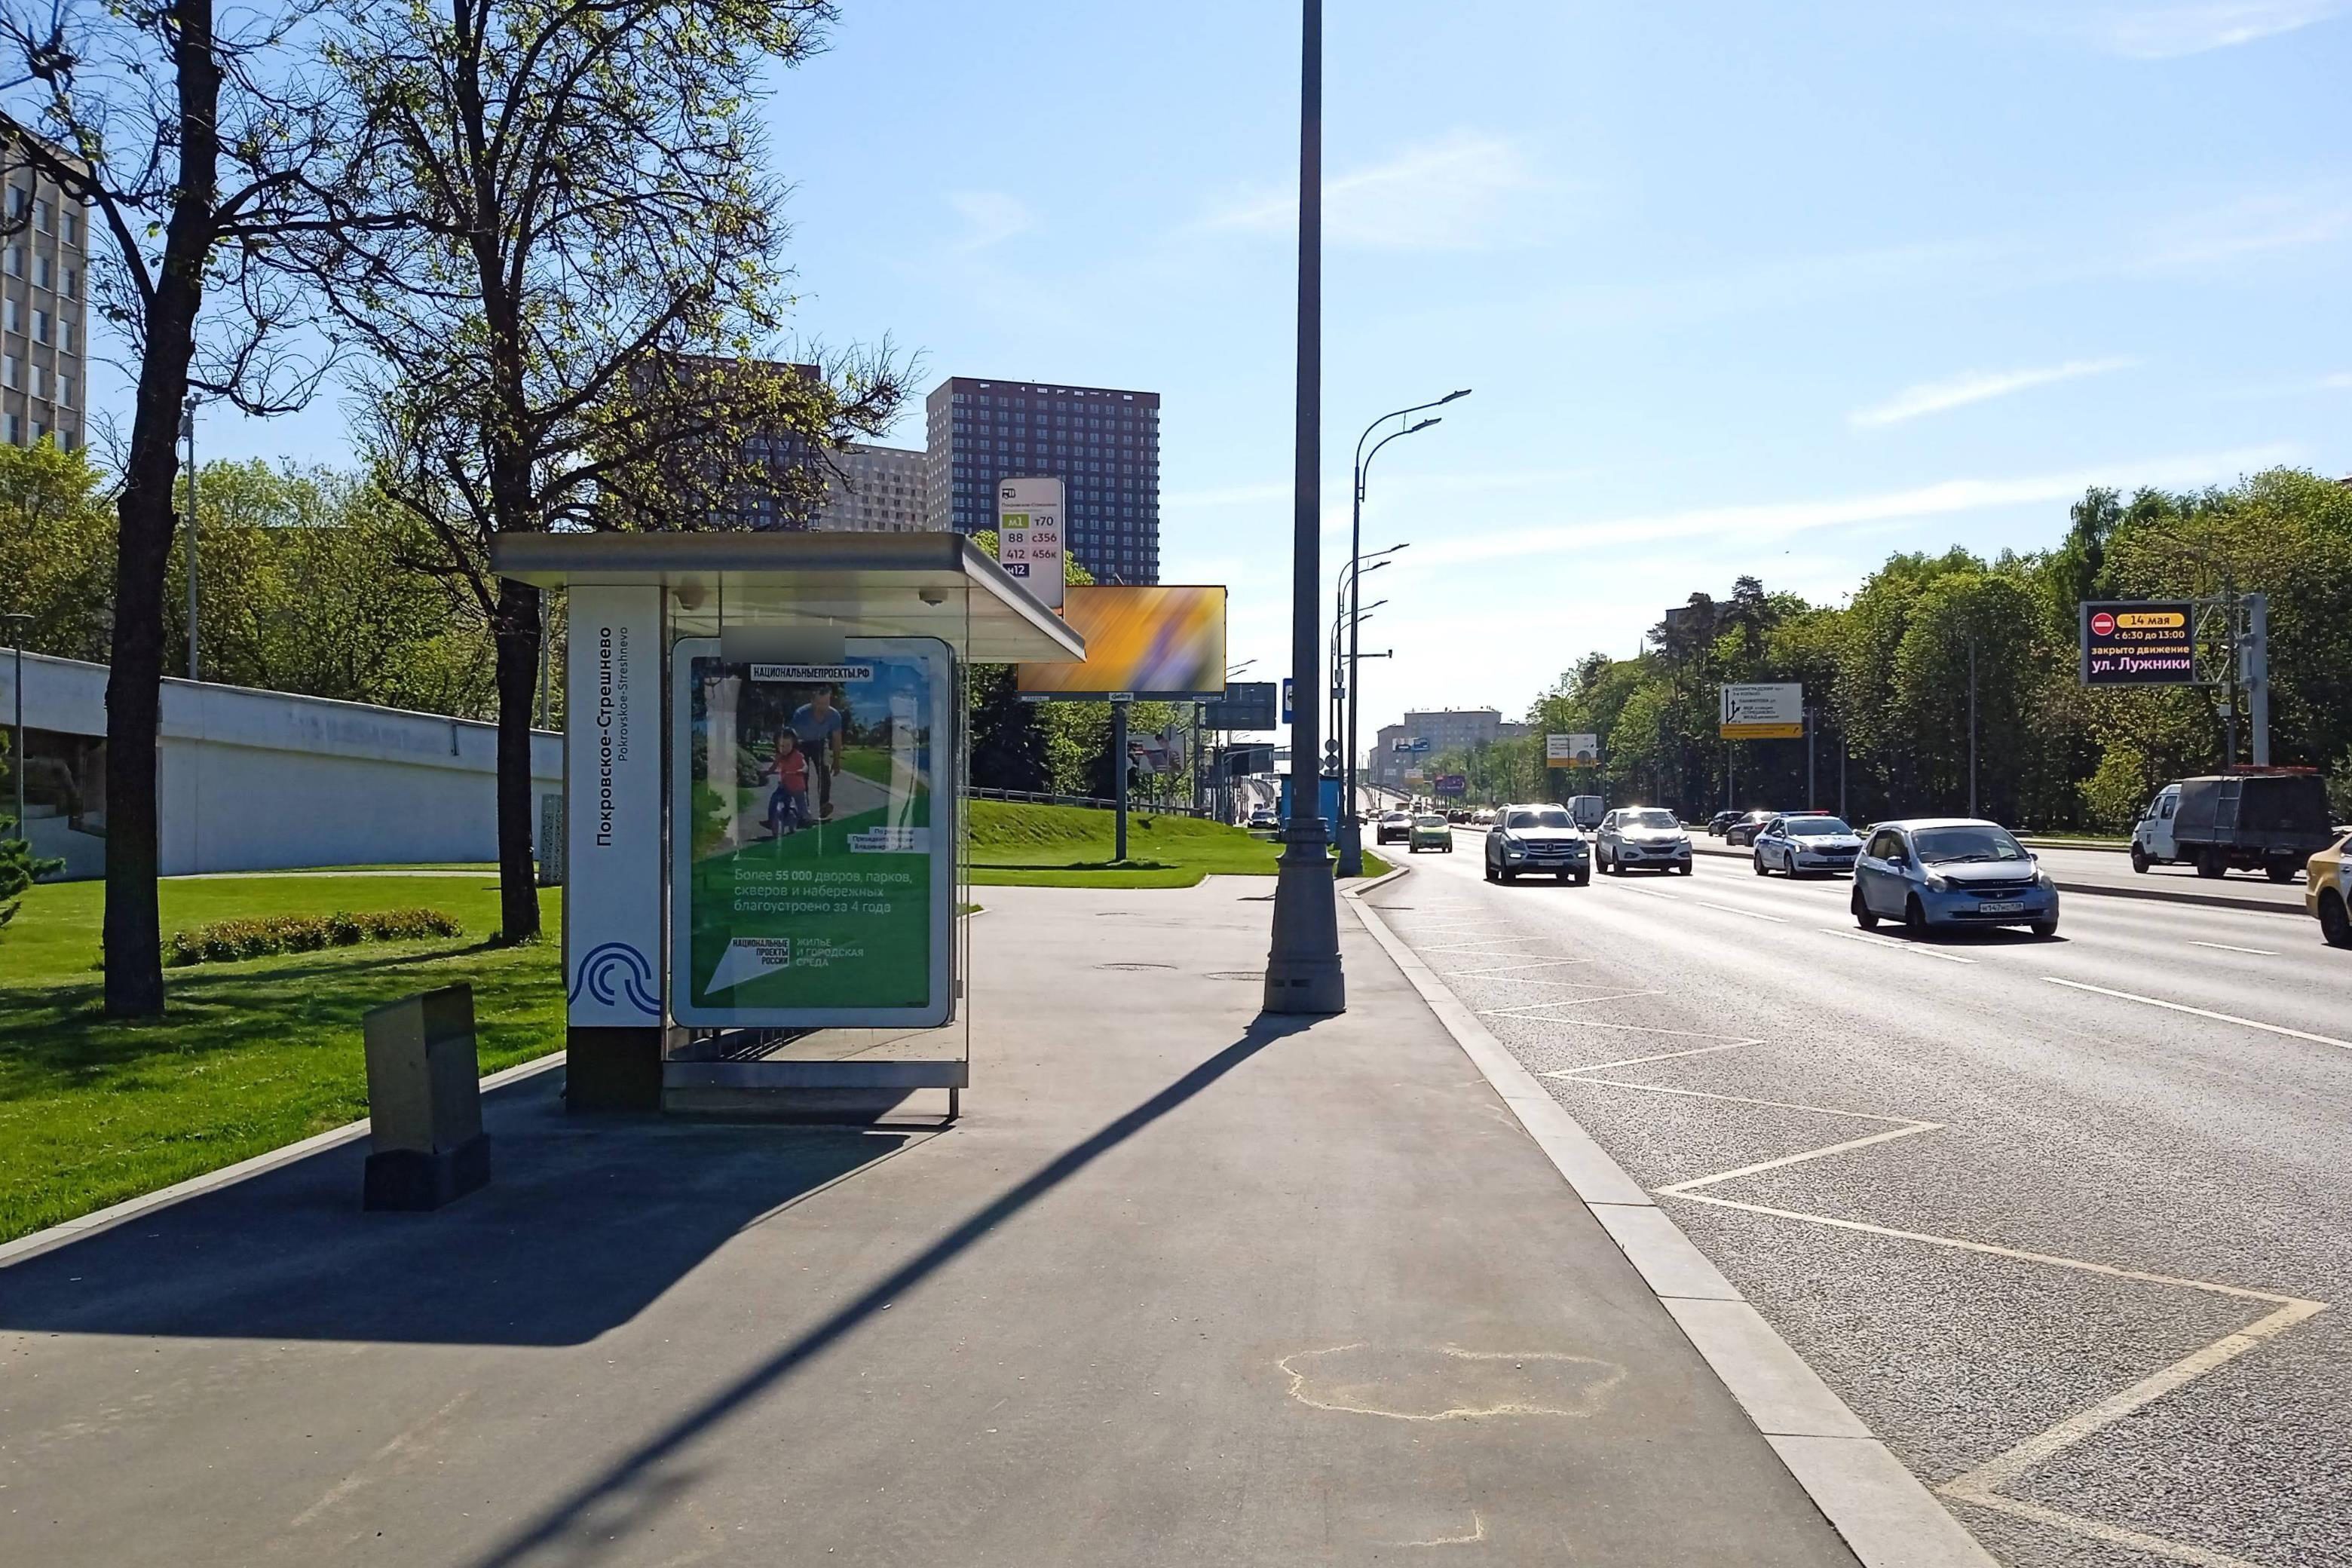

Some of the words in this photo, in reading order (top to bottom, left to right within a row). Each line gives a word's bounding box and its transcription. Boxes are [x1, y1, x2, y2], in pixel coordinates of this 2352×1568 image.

[1008, 517, 1024, 526] м1
[1034, 516, 1054, 526] т70
[1009, 533, 1024, 543] 88
[1032, 533, 1057, 543] с356
[1007, 550, 1025, 559] 412
[1032, 550, 1057, 559] 456к
[2130, 615, 2144, 625] 14
[2148, 617, 2170, 626] мая
[2122, 631, 2143, 639] 6:30
[2145, 632, 2157, 641] до
[2158, 630, 2185, 639] 13:00
[2091, 647, 2135, 656] закрыто
[2136, 645, 2190, 656] движение
[2091, 660, 2115, 674] ул.
[2118, 657, 2191, 673] Лужники
[754, 666, 870, 679] НАЦИОНАЛЬНЫЕПРОЕКТЫ.РФ
[618, 626, 629, 761] Pokrovskoe-Streshnevo
[596, 626, 615, 847] Покровское-Стрешнево
[735, 868, 773, 881] Более
[775, 871, 789, 880] 55
[792, 871, 813, 881] 000
[814, 871, 863, 884] дворов,
[866, 872, 912, 884] парков,
[734, 886, 788, 898] скверов
[792, 887, 799, 896] и
[803, 884, 884, 899] набережных
[733, 899, 830, 914] благоустроено
[833, 903, 847, 912] за
[850, 901, 859, 912] 4
[862, 903, 891, 915] года
[733, 939, 789, 948] НАЦИОНАЛЬНЫЕ
[796, 938, 831, 947] ЖИЛЬЕ
[756, 948, 789, 957] ПРОЕКТЫ
[796, 948, 804, 957] И
[805, 948, 865, 957] ГОРОДСКАЯ
[761, 957, 789, 966] РОССИИ
[796, 957, 829, 967] СРЕДА
